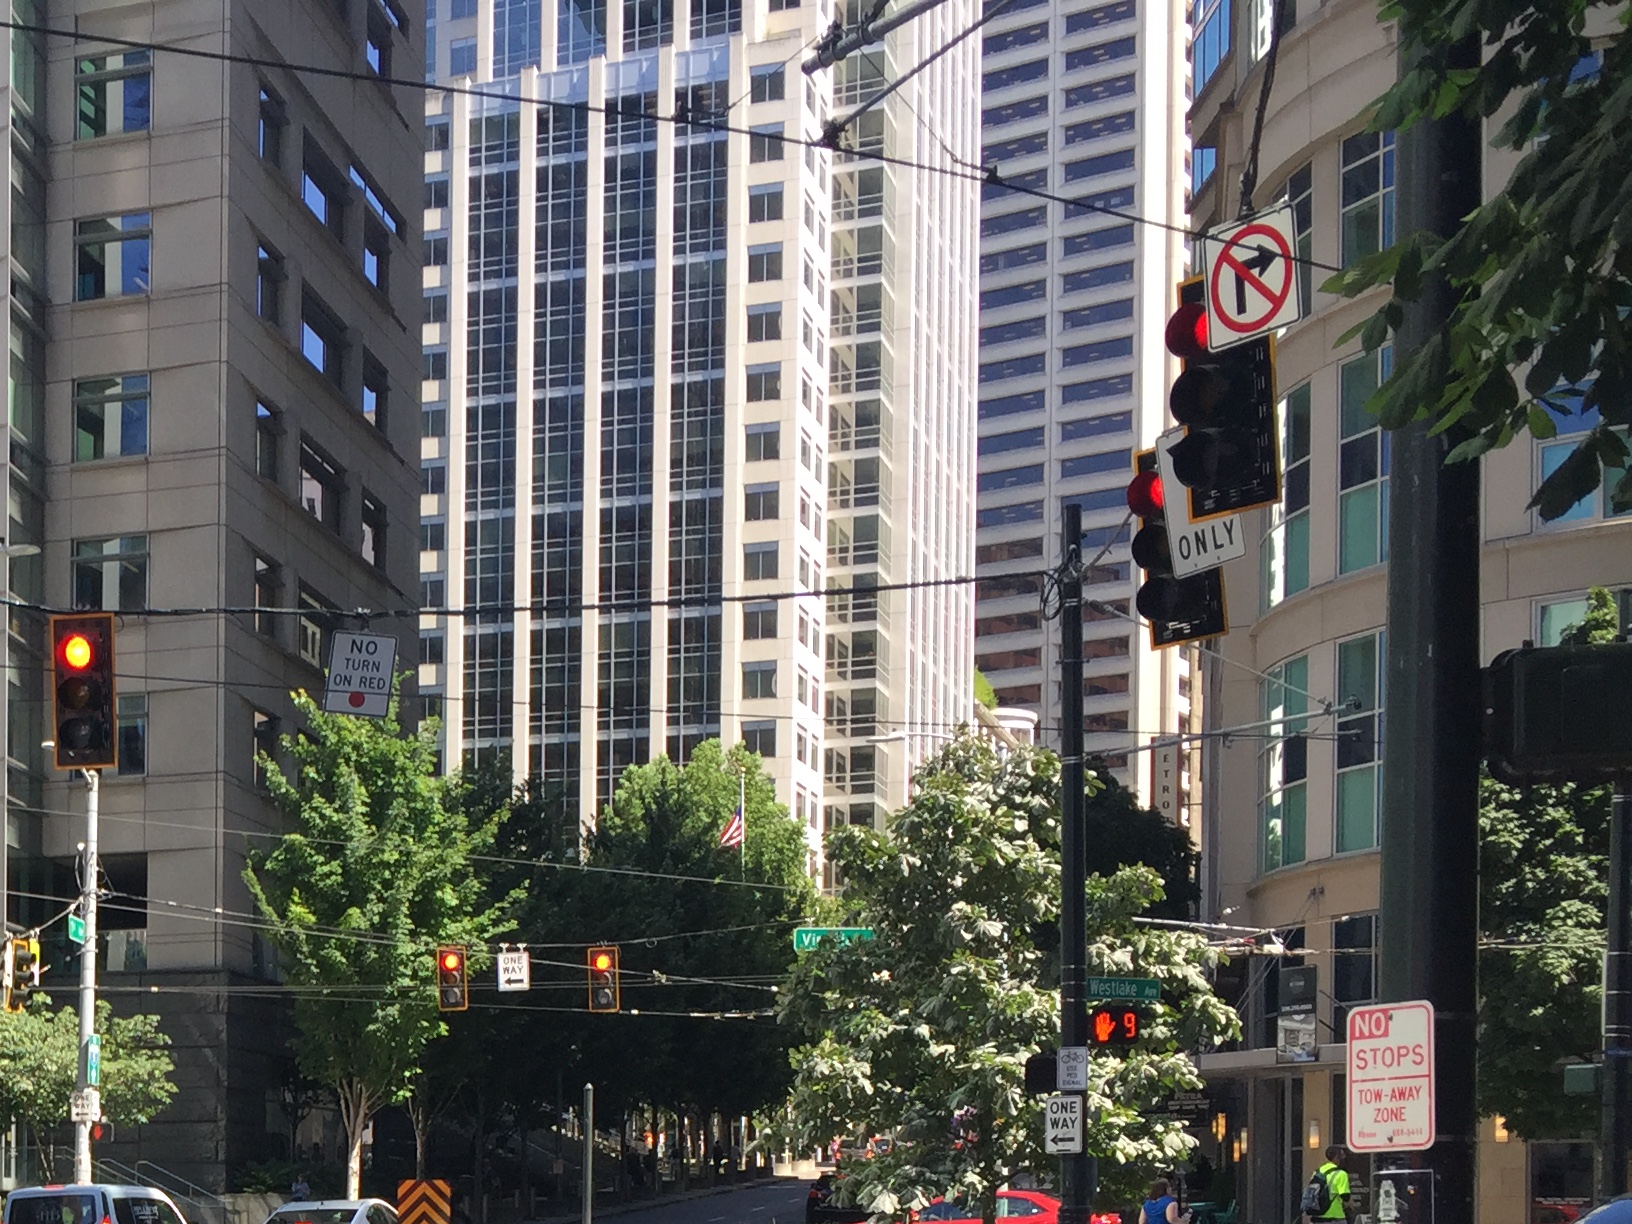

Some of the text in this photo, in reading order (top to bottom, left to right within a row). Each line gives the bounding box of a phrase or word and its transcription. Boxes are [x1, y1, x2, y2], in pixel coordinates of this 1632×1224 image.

[1179, 518, 1234, 560] ONLY
[350, 638, 378, 656] NO
[344, 658, 380, 672] TURN
[334, 674, 386, 690] ON RED
[503, 956, 523, 965] ONE
[503, 966, 523, 974] WAY
[1089, 979, 1157, 997] Westlake Ave
[1124, 1012, 1136, 1038] 9
[1355, 1012, 1386, 1038] NO
[1356, 1044, 1425, 1070] STOPS
[1358, 1085, 1423, 1104] TOW-AWAY
[1050, 1101, 1077, 1114] ONE
[1374, 1107, 1406, 1123] ZONE
[1050, 1117, 1078, 1130] WAY
